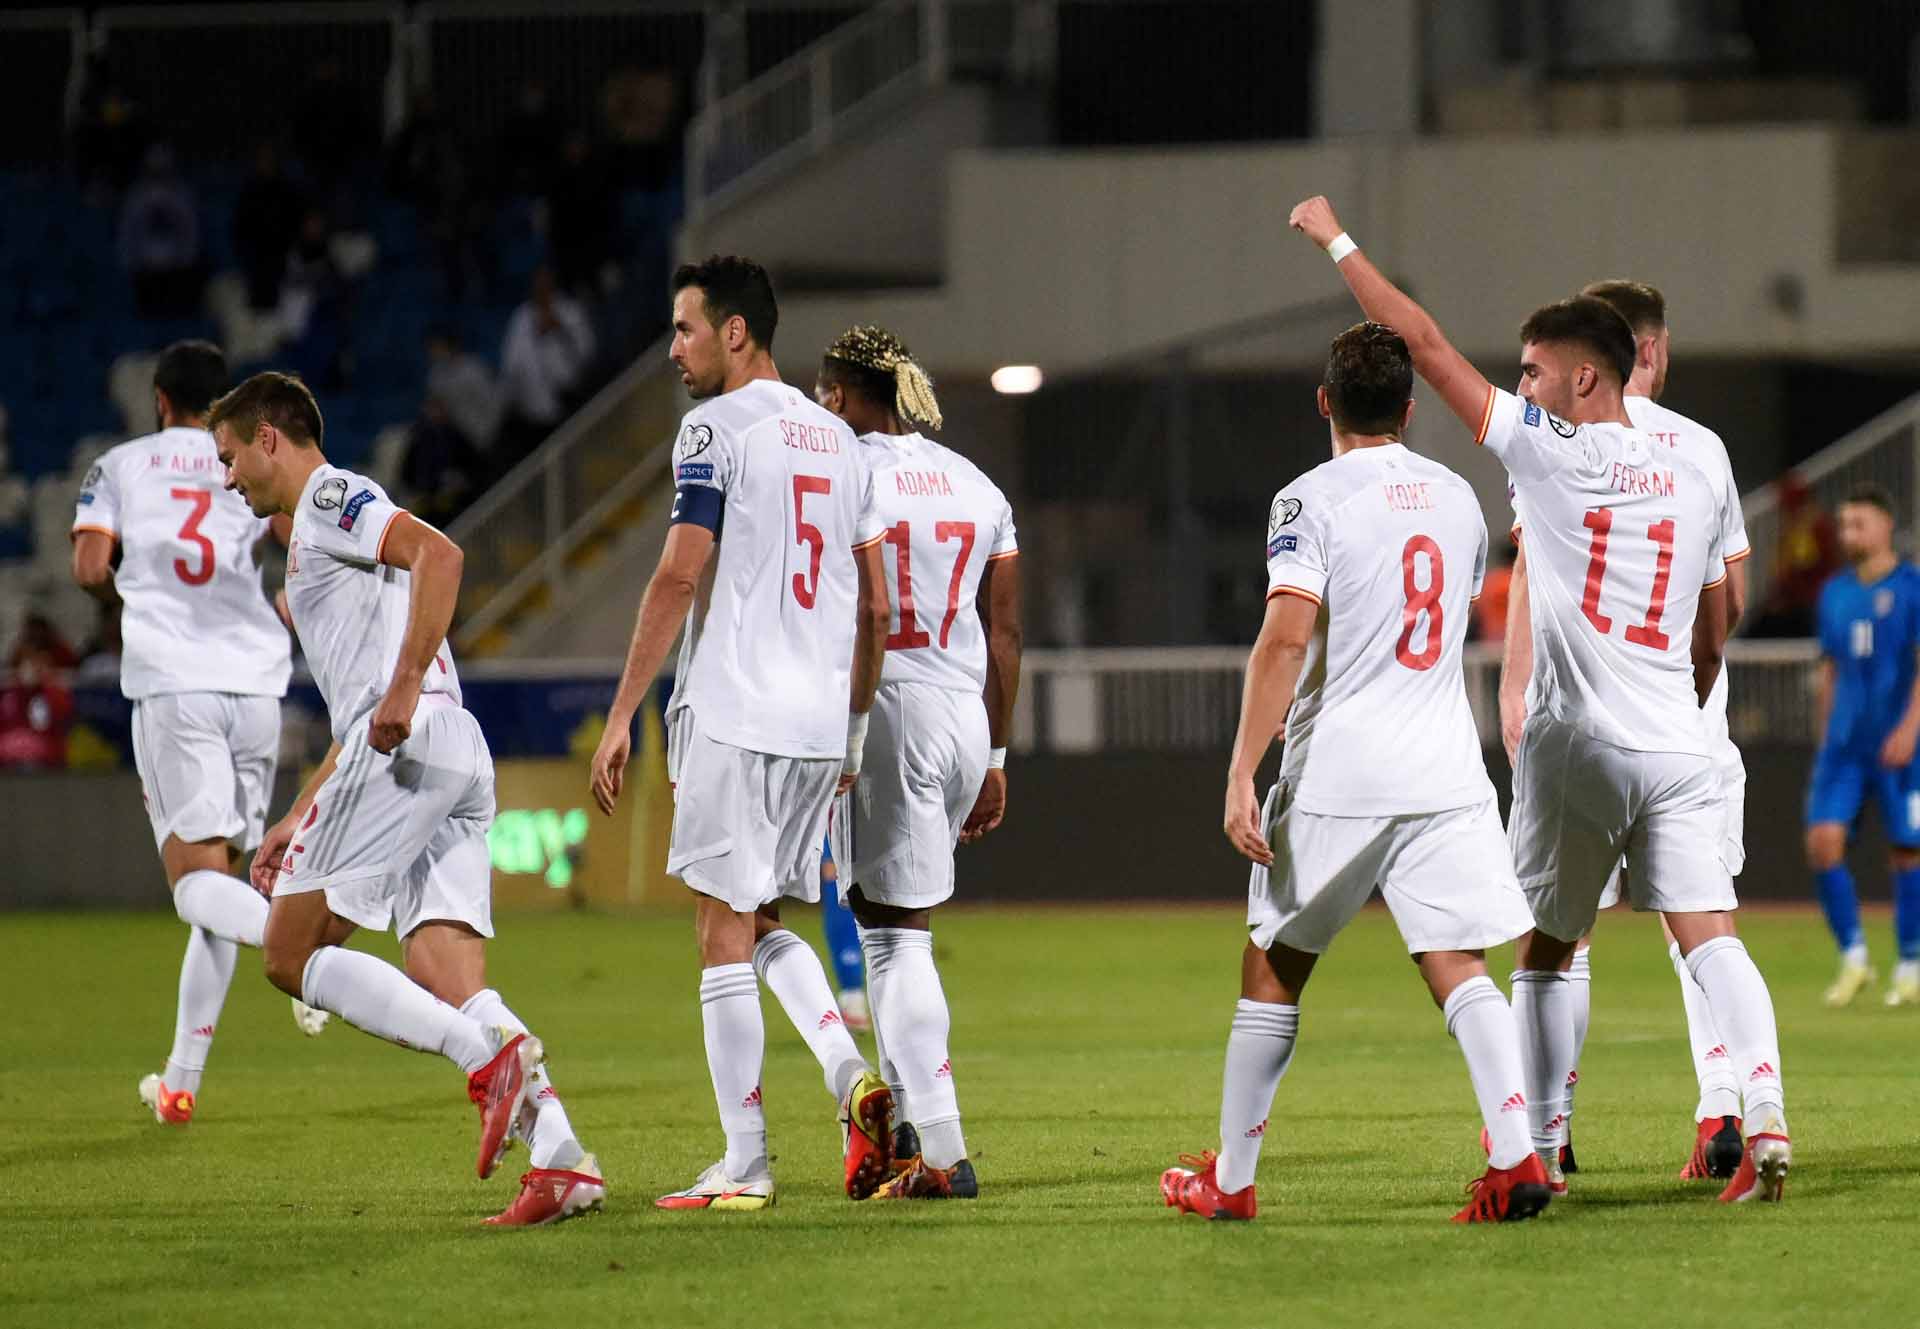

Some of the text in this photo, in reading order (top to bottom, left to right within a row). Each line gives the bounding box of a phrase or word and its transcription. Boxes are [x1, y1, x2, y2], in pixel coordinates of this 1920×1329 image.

[779, 419, 839, 454] SERGIO
[895, 471, 953, 497] ADAMA
[1609, 461, 1677, 498] FERRAN
[170, 488, 216, 587] 3
[792, 474, 831, 610] 5
[1383, 482, 1436, 512] KOKE
[884, 520, 975, 652] 17
[1395, 534, 1445, 672] 8
[1581, 506, 1677, 651] 11
